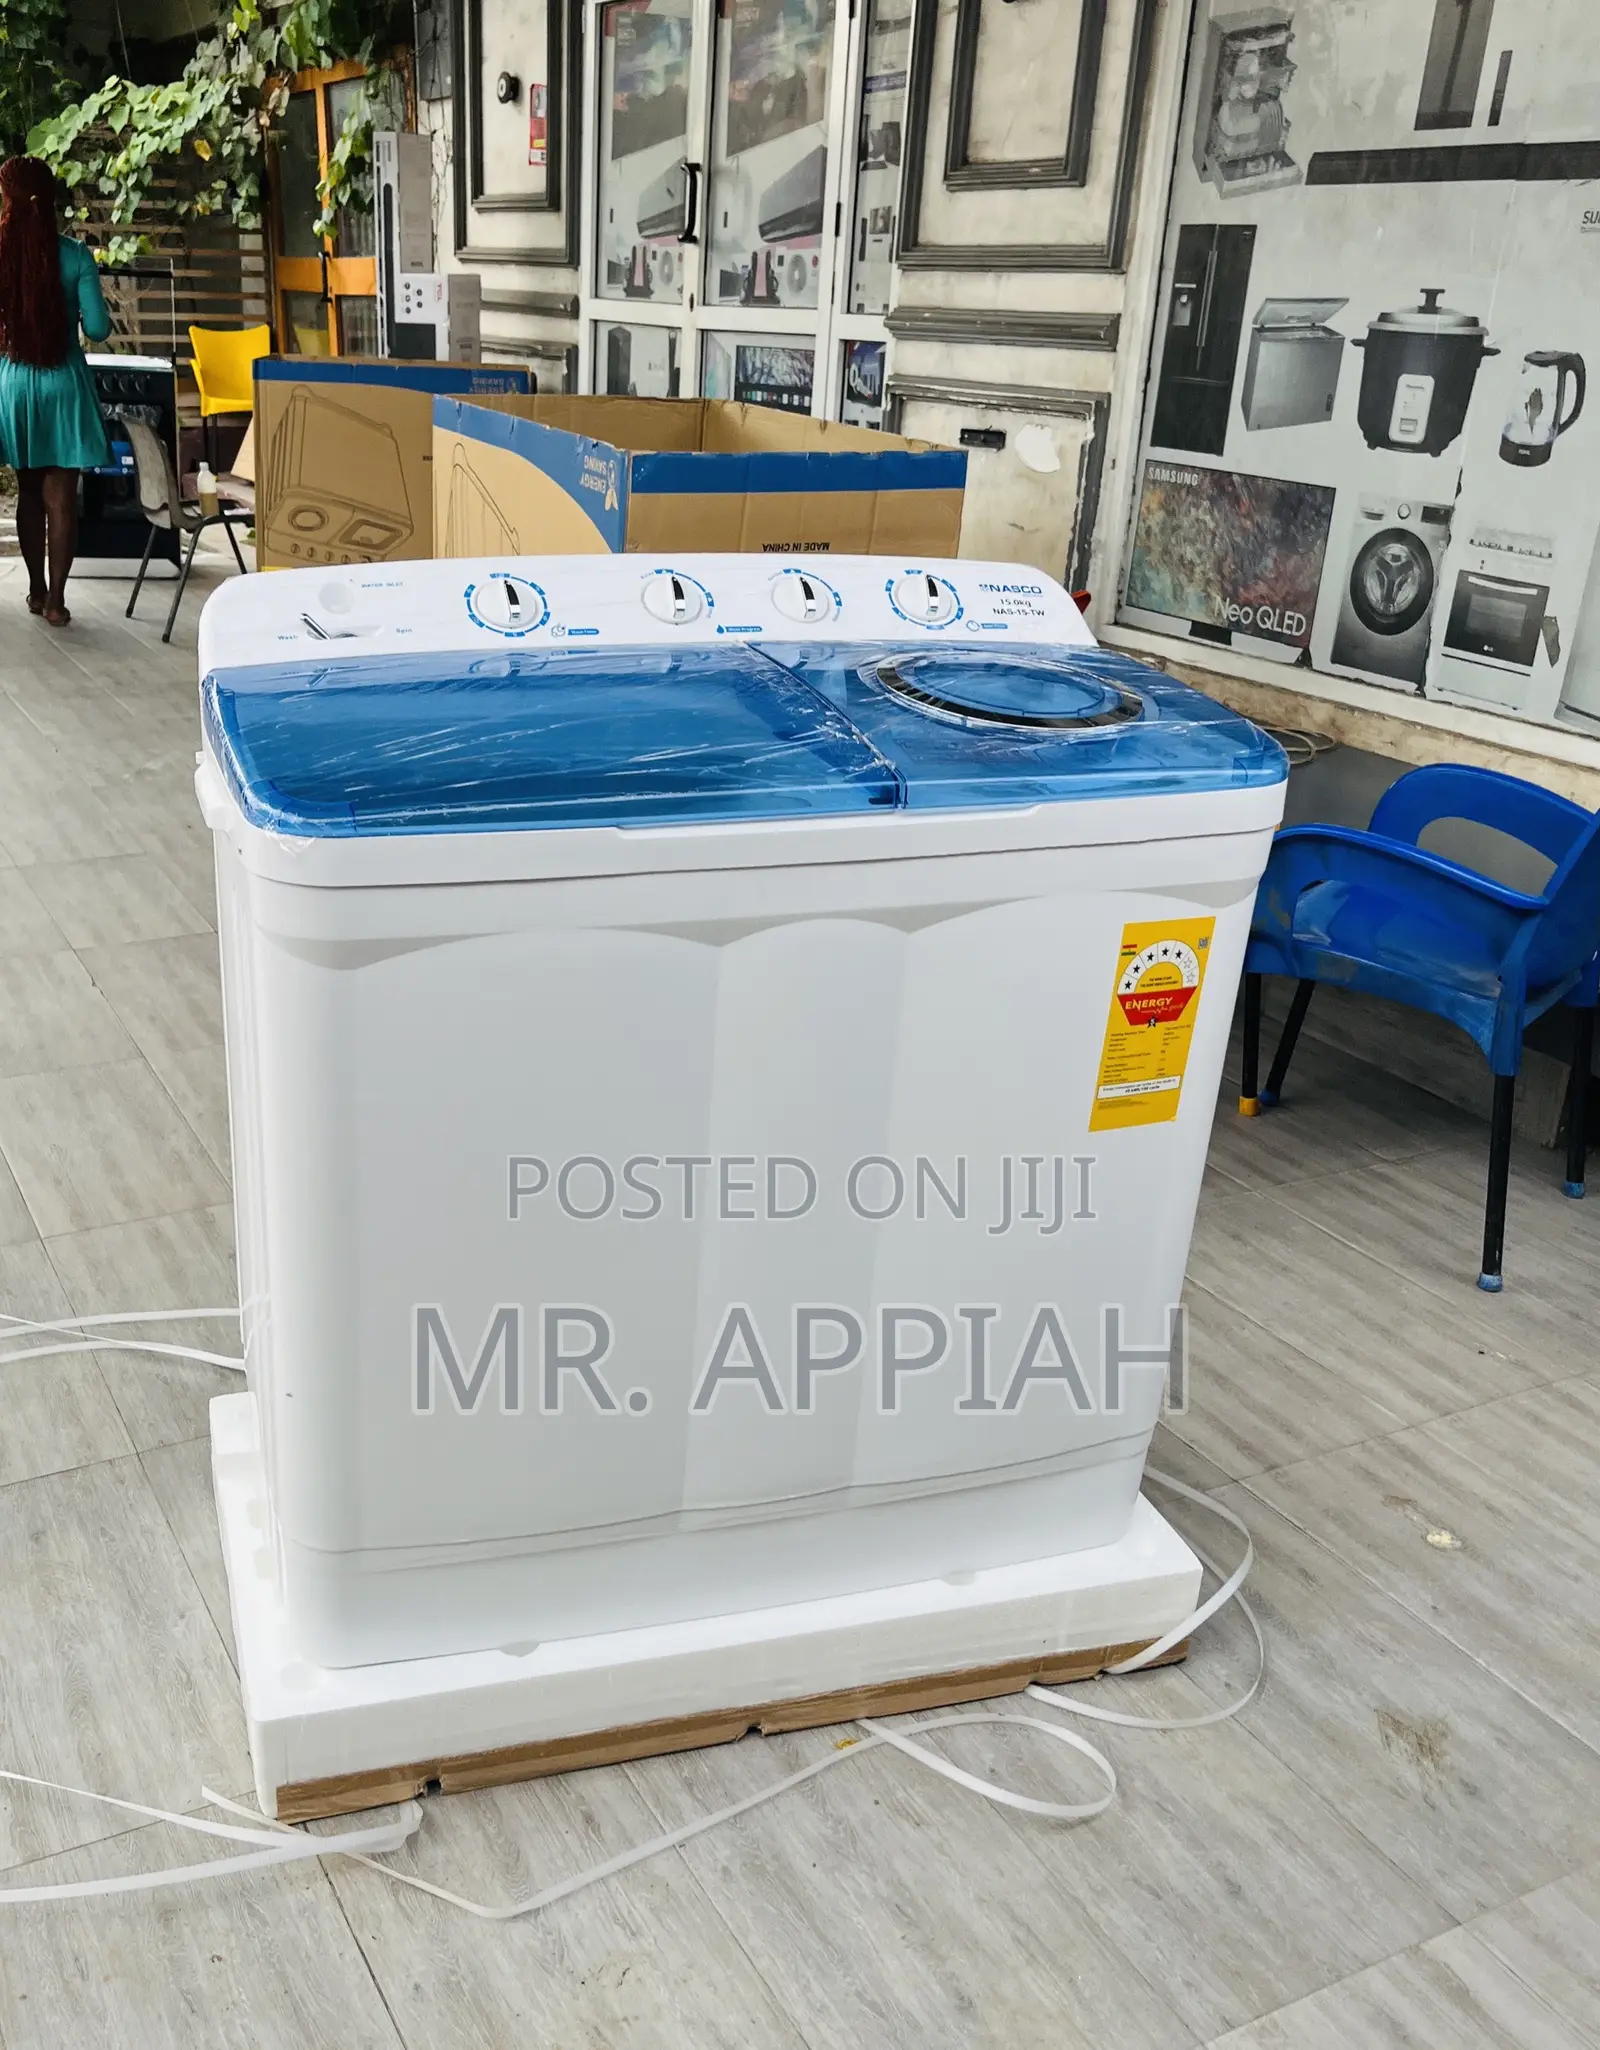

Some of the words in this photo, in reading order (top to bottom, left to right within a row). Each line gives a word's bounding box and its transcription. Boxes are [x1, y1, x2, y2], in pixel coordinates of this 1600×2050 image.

[1148, 467, 1199, 486] SAMSUNG
[580, 471, 606, 495] ENERGY
[762, 543, 790, 552] CHINA
[792, 543, 801, 551] IN
[804, 542, 830, 551] MADE
[989, 584, 1042, 594] NASCO
[1000, 598, 1031, 608] 15.0kg
[992, 608, 1045, 616] NAS-15-TW
[1213, 595, 1254, 625] Neo
[1256, 605, 1307, 636] QLED
[1125, 997, 1173, 1011] ENERGY
